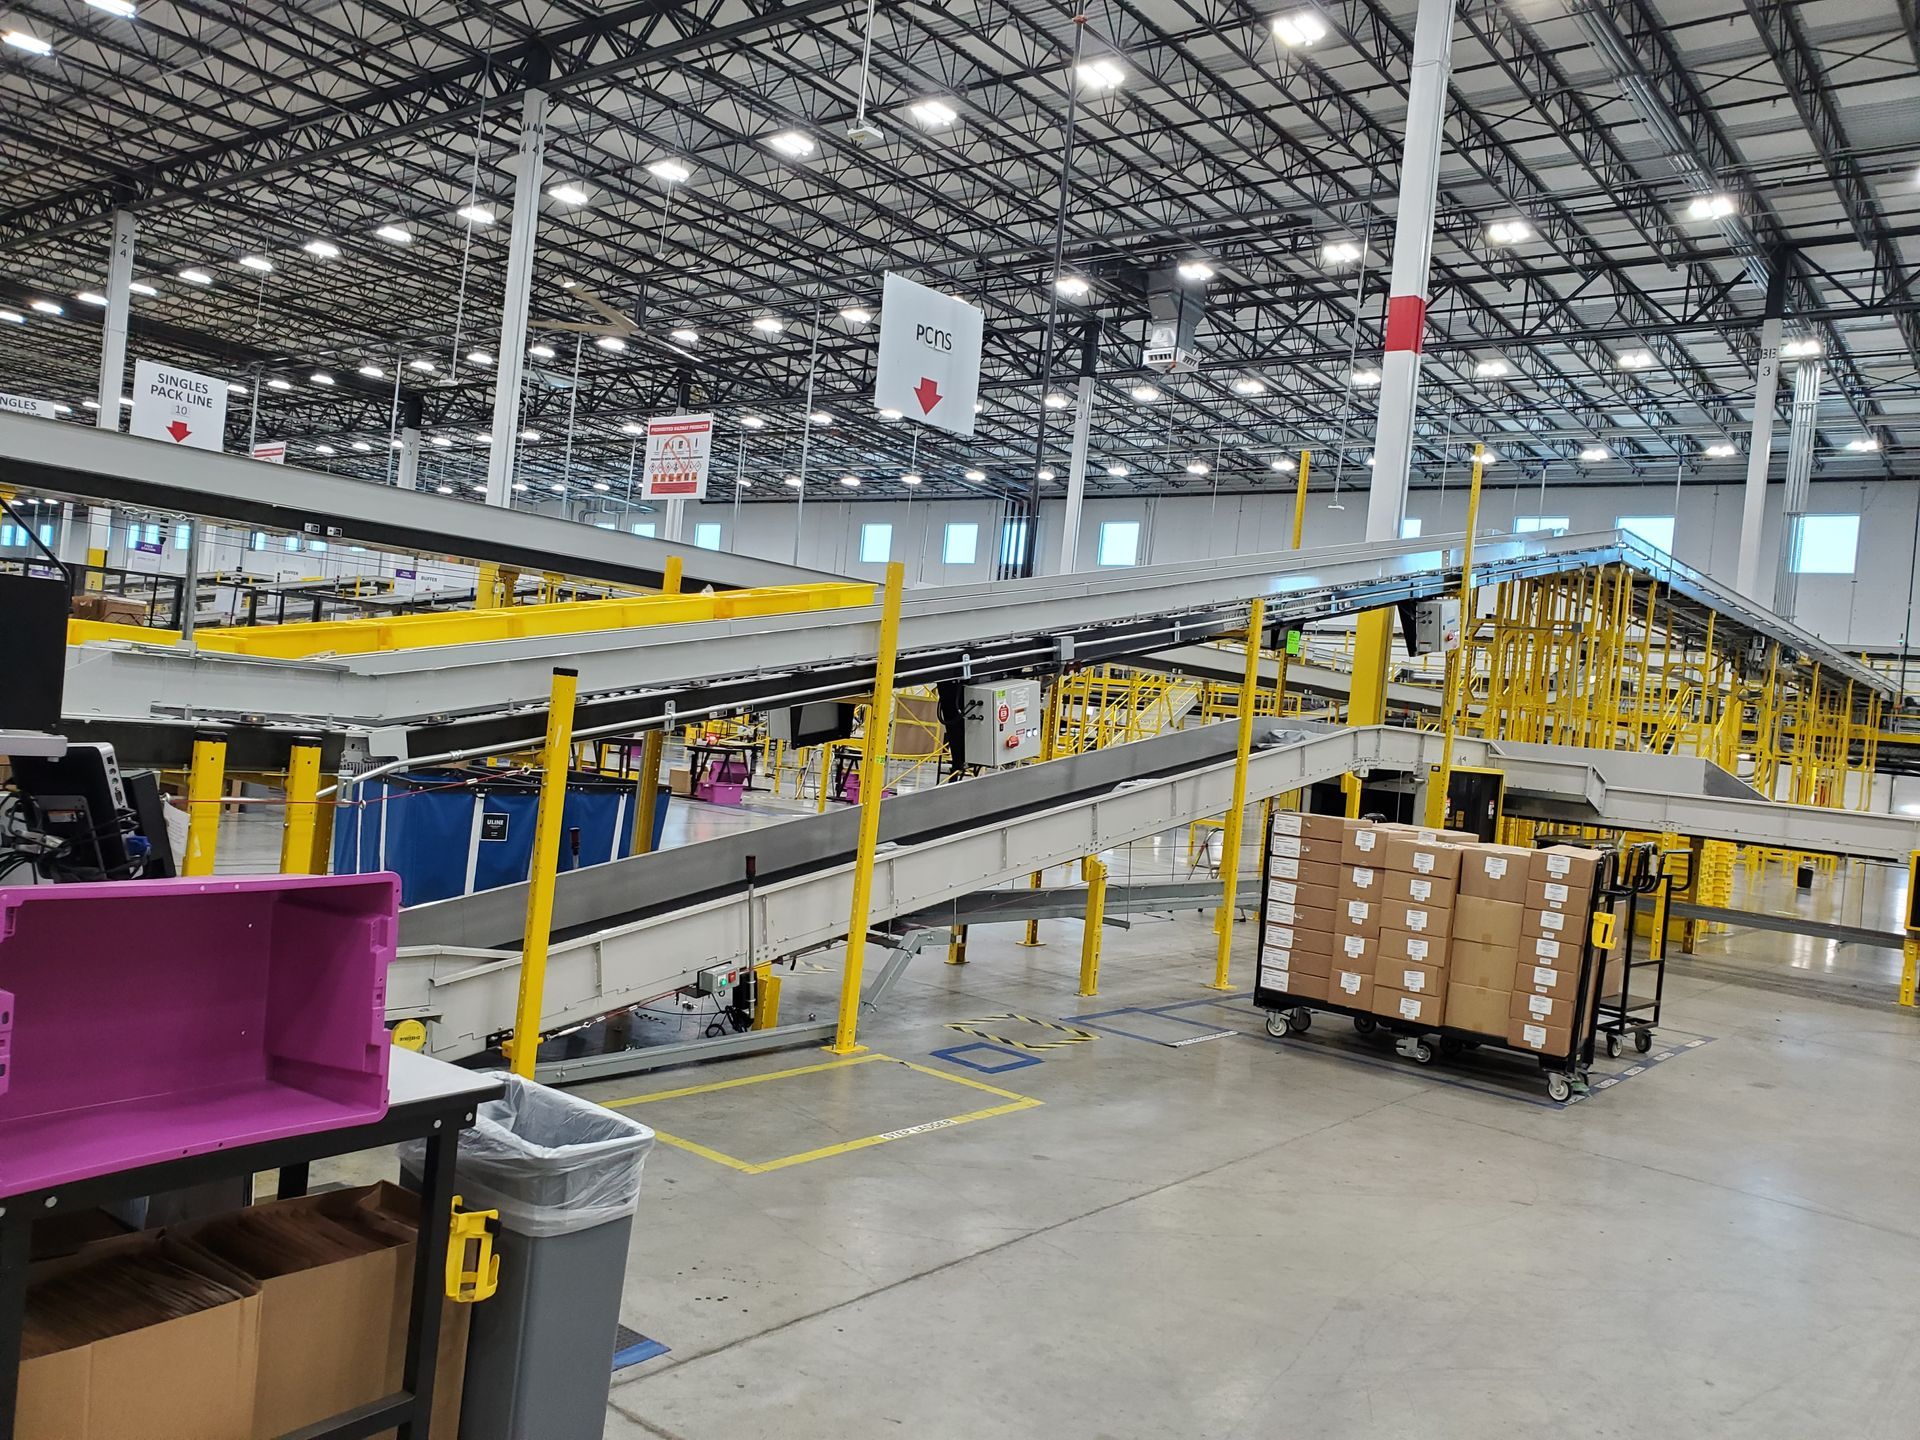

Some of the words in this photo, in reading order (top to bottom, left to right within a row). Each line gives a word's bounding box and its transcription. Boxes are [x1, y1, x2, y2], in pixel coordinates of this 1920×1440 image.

[158, 373, 208, 394] SINGLES
[150, 384, 183, 402] PACK
[187, 393, 213, 408] LINE
[175, 405, 188, 415] 10
